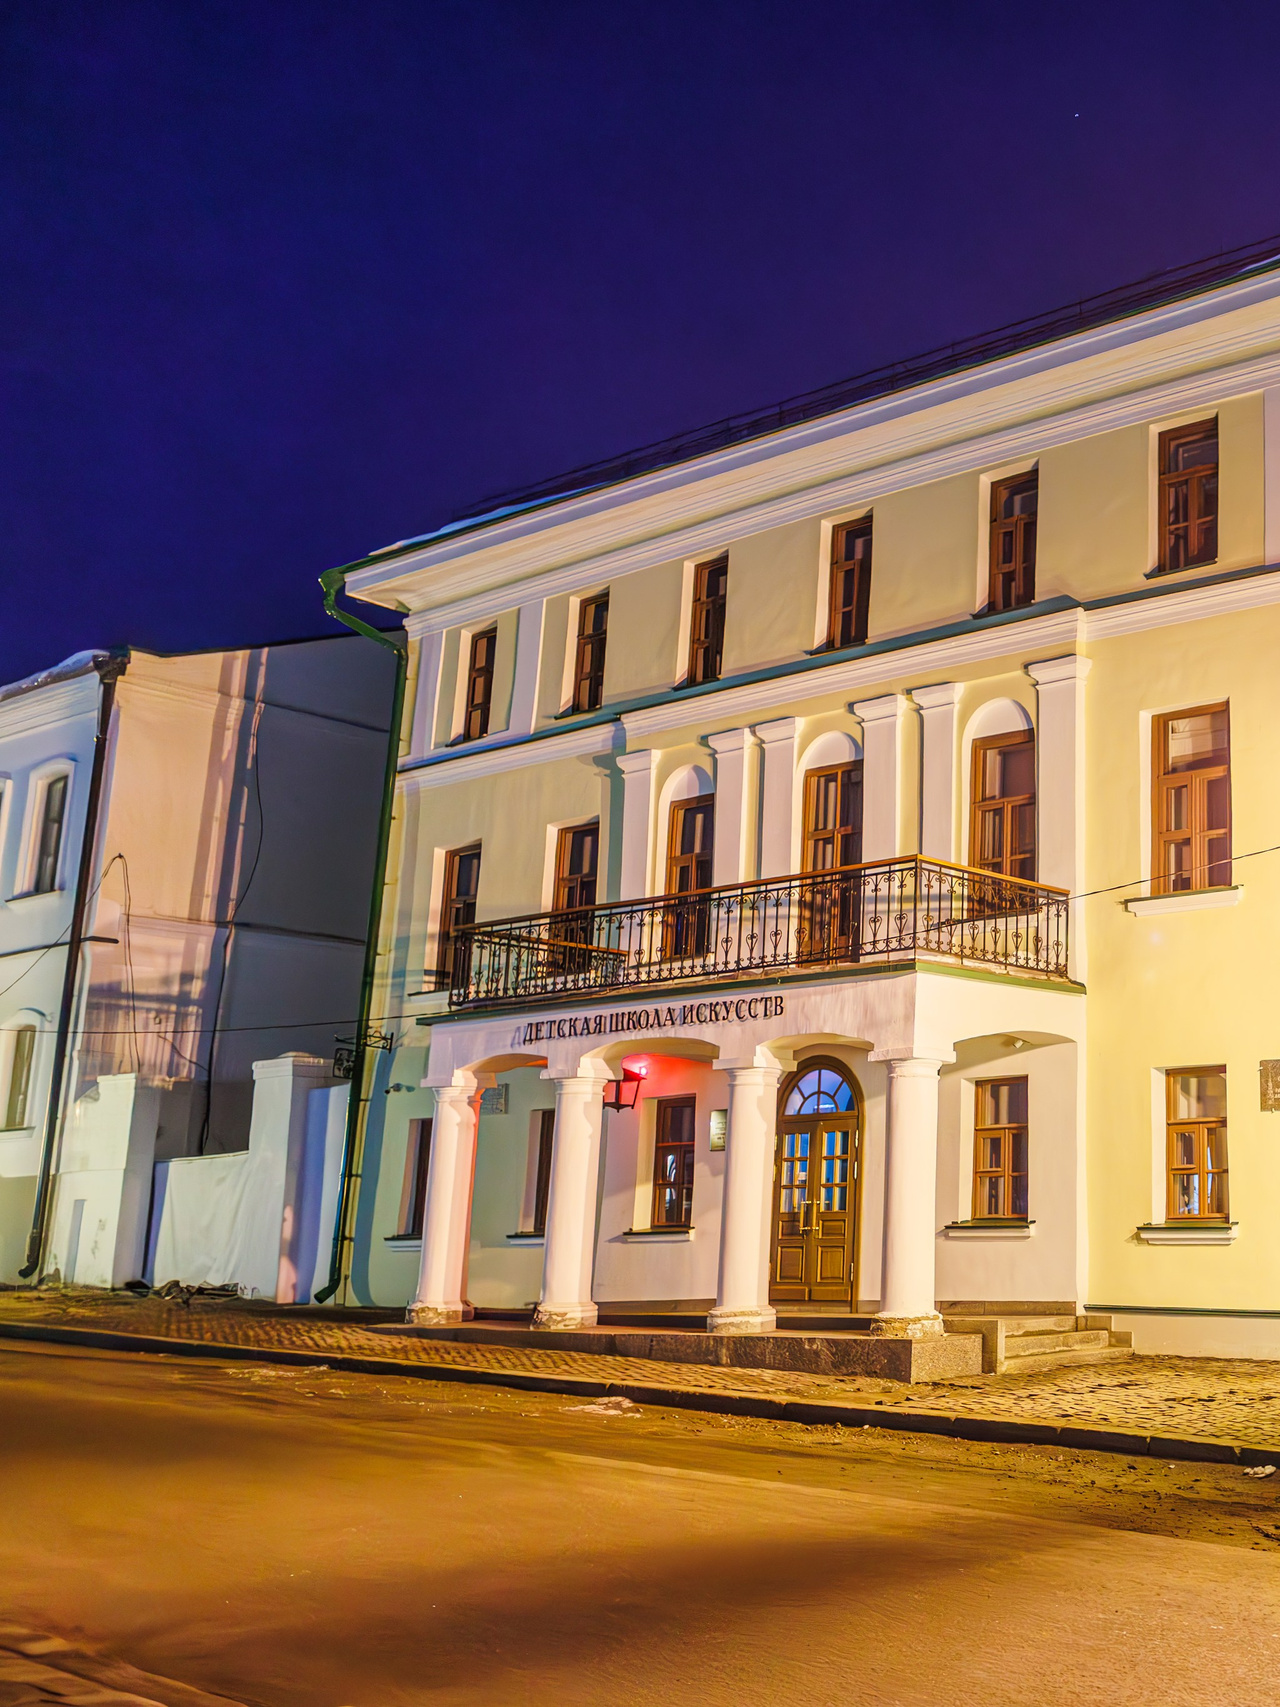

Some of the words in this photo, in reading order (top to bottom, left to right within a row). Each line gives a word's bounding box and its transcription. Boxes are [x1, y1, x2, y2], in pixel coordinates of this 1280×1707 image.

[523, 1014, 603, 1046] ДЕТСКАЯ
[609, 1006, 675, 1032] ШКОЛА
[682, 995, 784, 1025] ИСКУССТВ
